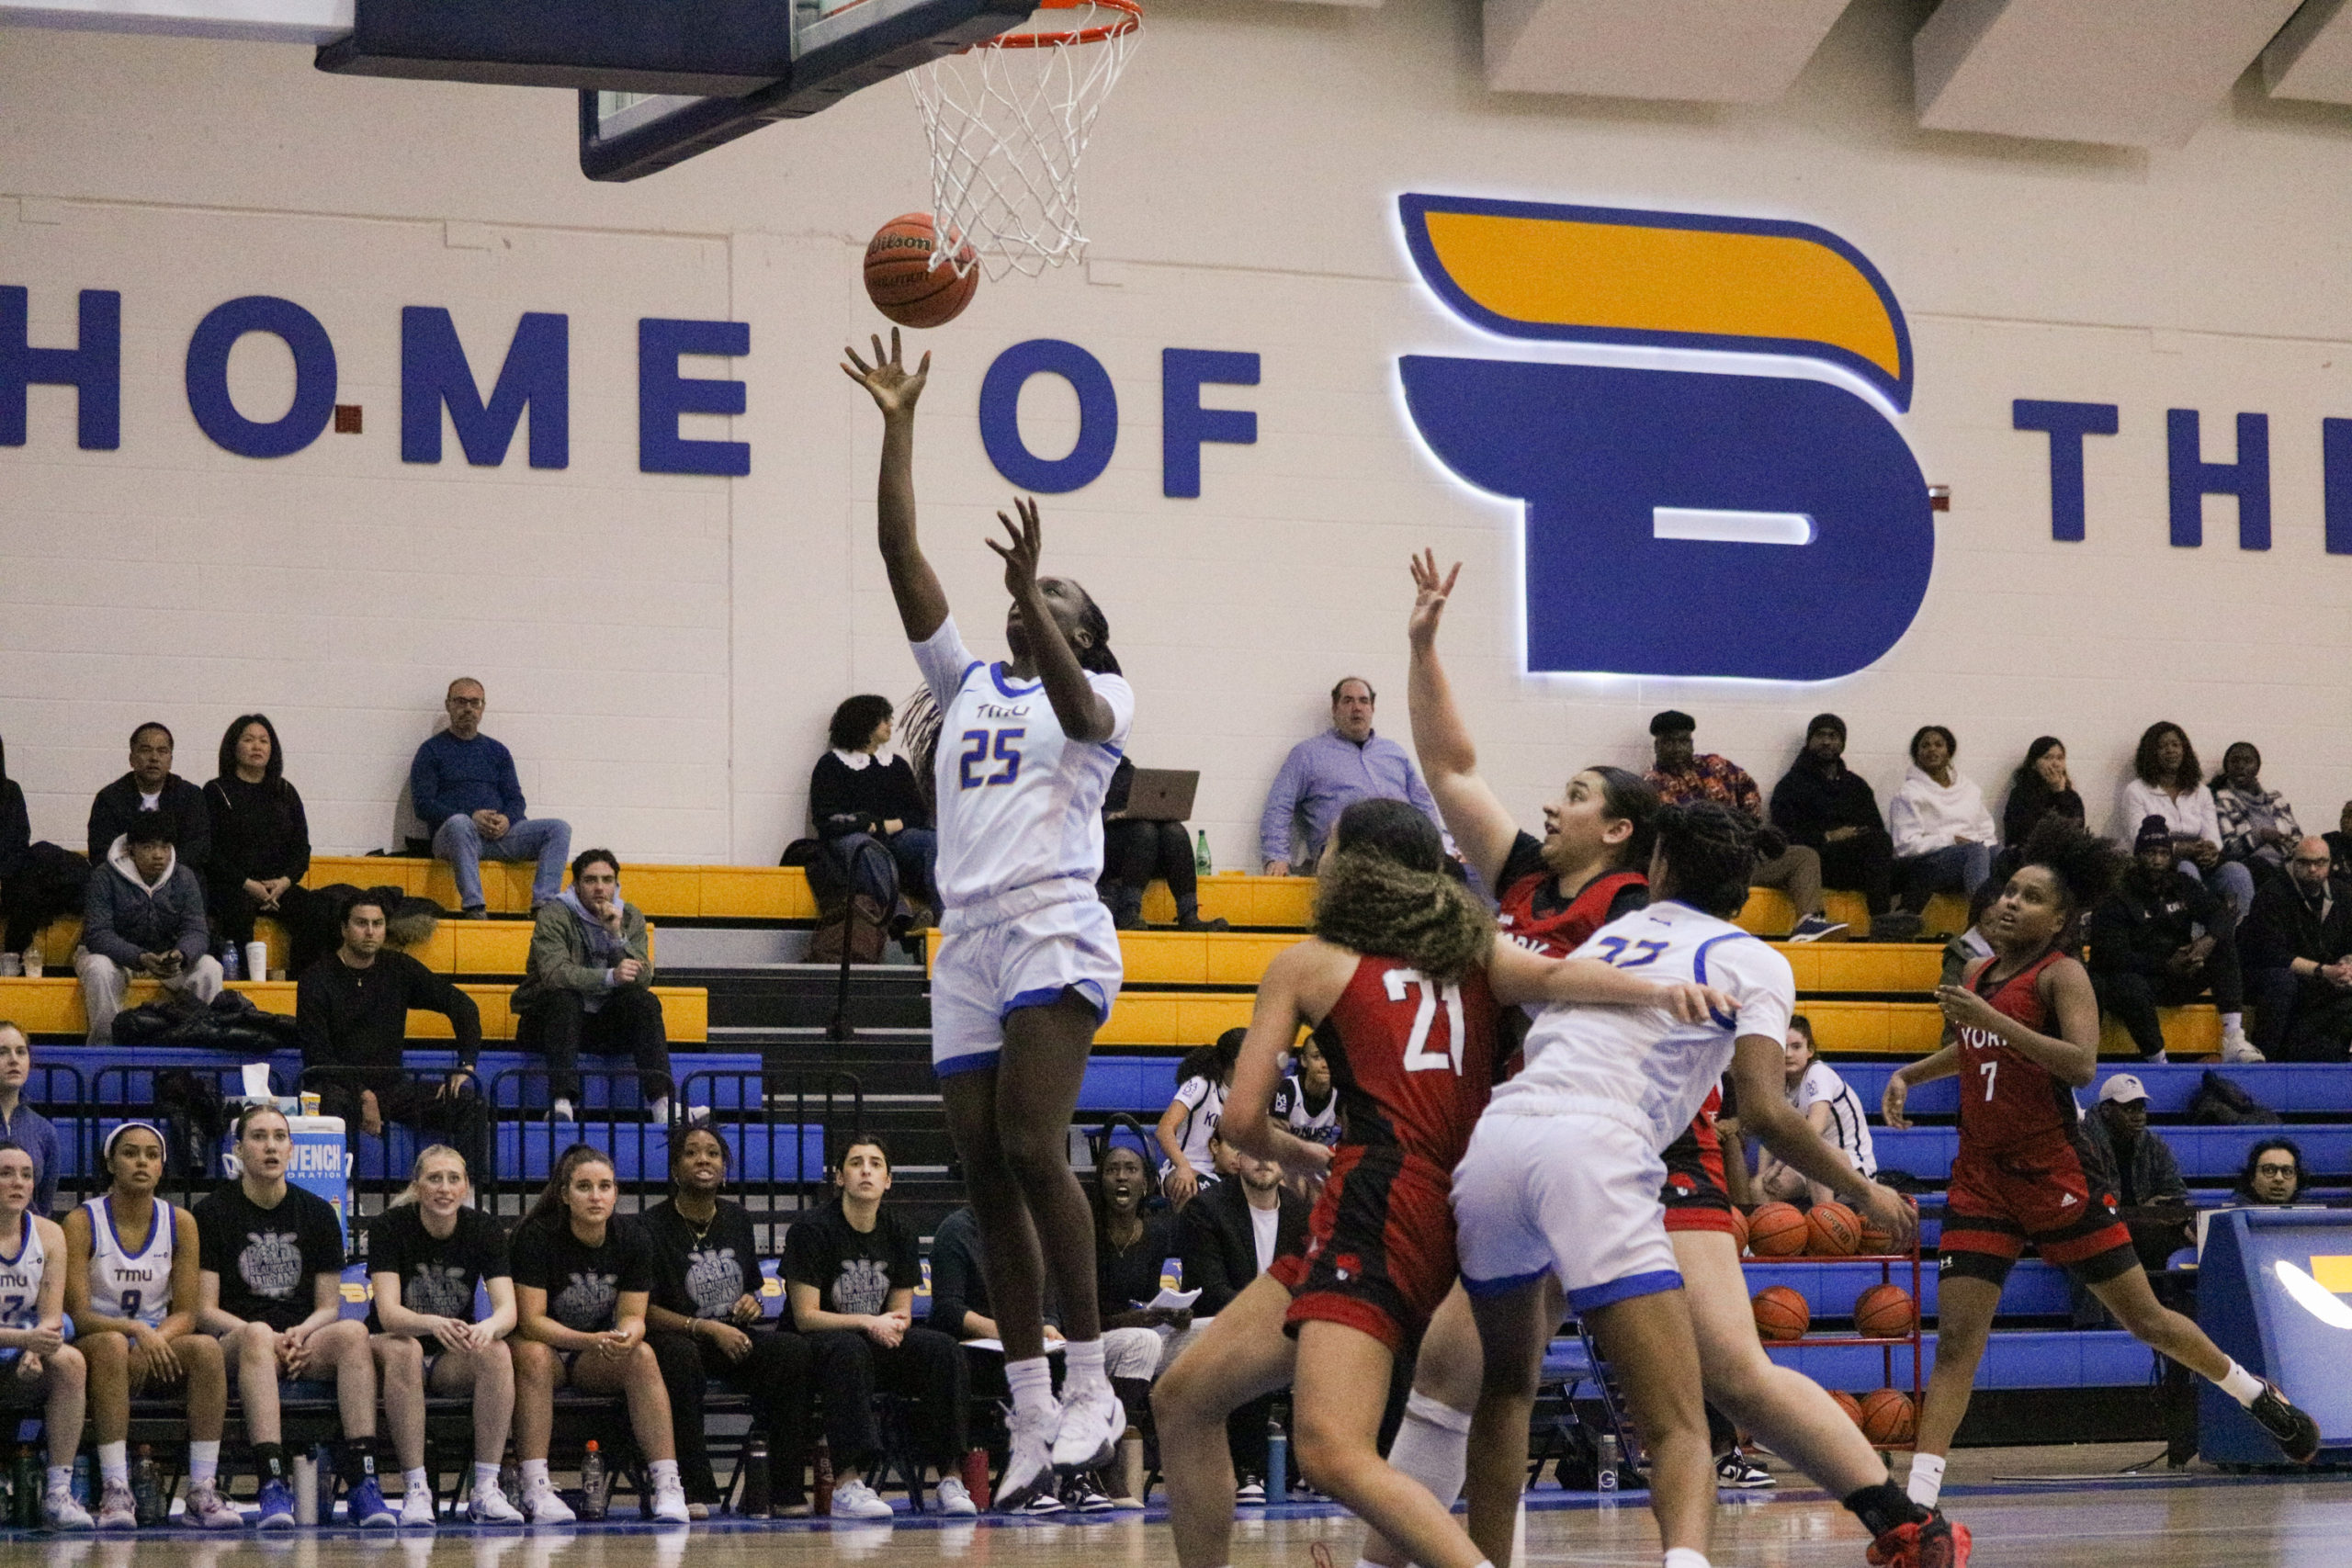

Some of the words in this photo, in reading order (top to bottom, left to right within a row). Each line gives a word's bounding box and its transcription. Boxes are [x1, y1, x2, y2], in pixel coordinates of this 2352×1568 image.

[0, 286, 750, 477] HOME
[979, 339, 1261, 496] OF
[2013, 400, 2352, 555] TH
[960, 728, 1026, 791] 25
[1382, 967, 1465, 1077] 21
[1961, 1026, 2008, 1050] YOR
[1980, 1061, 1997, 1101] 7
[114, 1269, 153, 1281] TMU
[121, 1290, 141, 1319] 9
[1600, 1470, 1616, 1488] G
